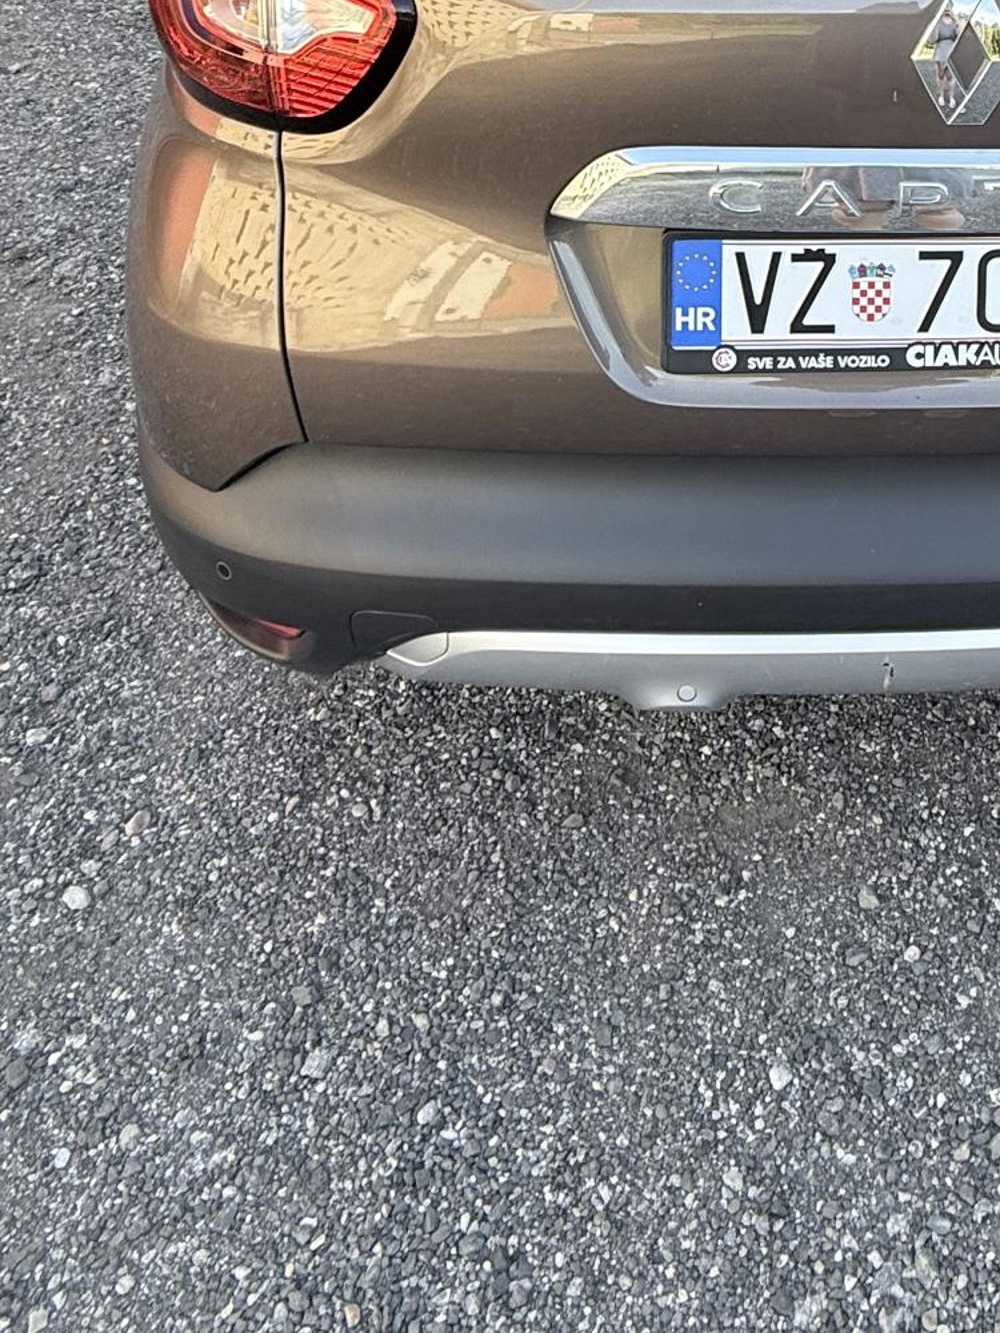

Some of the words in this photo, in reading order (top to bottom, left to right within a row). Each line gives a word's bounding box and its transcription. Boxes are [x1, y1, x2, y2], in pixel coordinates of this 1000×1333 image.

[735, 248, 836, 334] VŽ
[675, 307, 716, 331] HR
[747, 357, 774, 370] SVE
[777, 357, 794, 369] ZA
[798, 353, 834, 368] VAŠE
[838, 354, 890, 367] VOZILO
